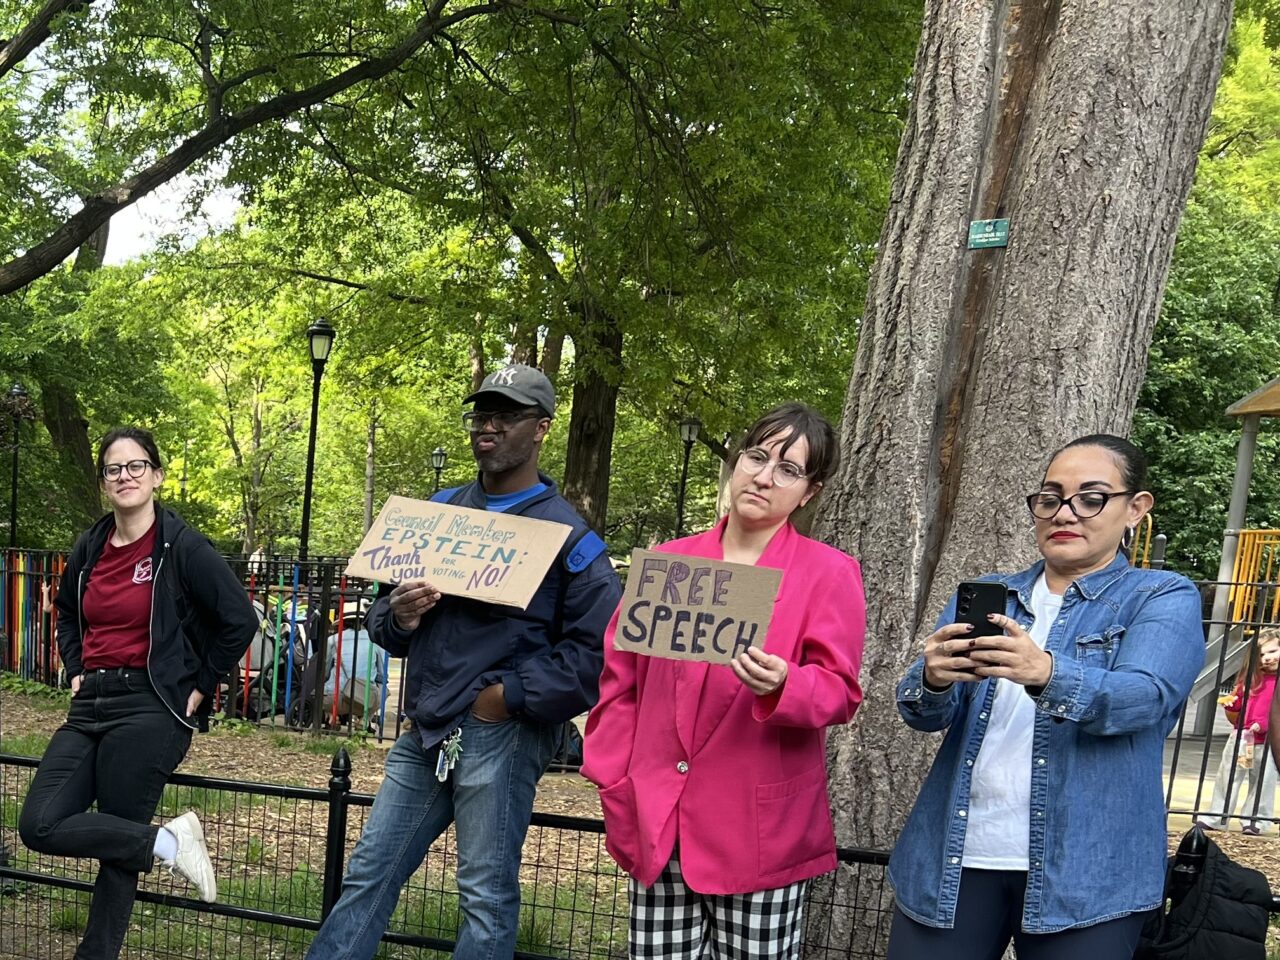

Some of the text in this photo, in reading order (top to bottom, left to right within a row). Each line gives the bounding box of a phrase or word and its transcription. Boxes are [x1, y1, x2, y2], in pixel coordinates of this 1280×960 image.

[384, 507, 516, 544] Council Member
[362, 545, 422, 571] Thank
[441, 557, 457, 566] FOR
[389, 566, 426, 585] you
[432, 567, 466, 580] VOTING
[466, 564, 510, 591] NO!
[636, 558, 733, 606] FREE
[622, 600, 758, 659] SPEECH
